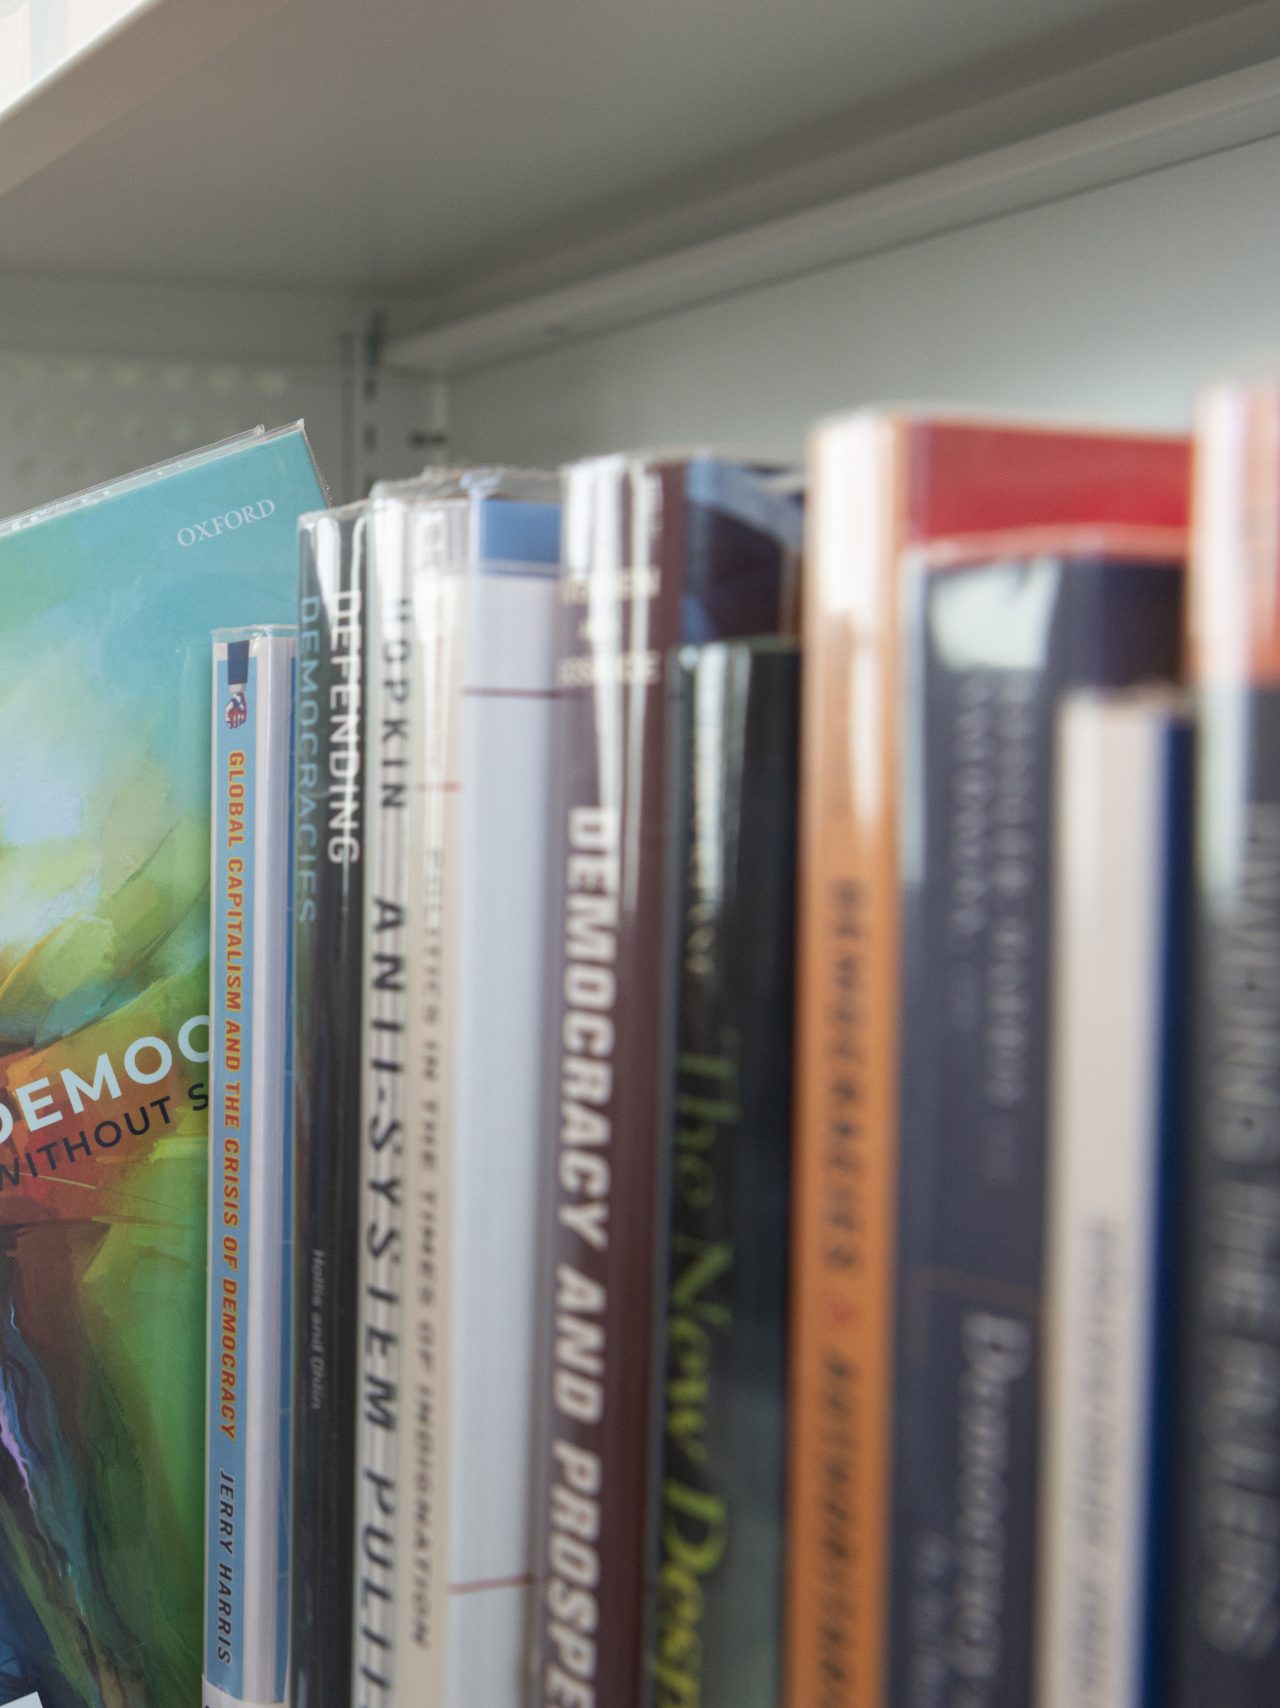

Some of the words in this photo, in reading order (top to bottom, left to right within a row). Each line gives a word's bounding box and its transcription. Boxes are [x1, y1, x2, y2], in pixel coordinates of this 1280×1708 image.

[177, 499, 275, 546] OXFORD
[299, 596, 320, 923] DEMOCRACIES
[327, 590, 361, 864] DEFENDING
[228, 750, 245, 848] GLOBAL
[226, 858, 244, 1011] CAPITALISM
[225, 1020, 241, 1072] AND
[420, 1038, 440, 1082] IN
[558, 804, 619, 1251] DEMOCRACY
[188, 1082, 209, 1111] S
[224, 1081, 241, 1129] THE
[419, 1098, 439, 1171] THE
[676, 1027, 742, 1210] The
[223, 1137, 240, 1231] CRISIS
[223, 1235, 238, 1272] OF
[417, 1190, 438, 1308] TIMES
[220, 1279, 238, 1442] DEMOCRACY
[310, 1311, 325, 1354] and
[416, 1320, 437, 1374] OF
[555, 1263, 607, 1424] AND
[668, 1233, 733, 1465] New
[218, 1470, 235, 1554] JERRY
[412, 1384, 435, 1649] INDIGNATION
[217, 1563, 234, 1664] HARRIS
[359, 1467, 397, 1708] POLITI
[545, 1438, 602, 1708] PROSPE
